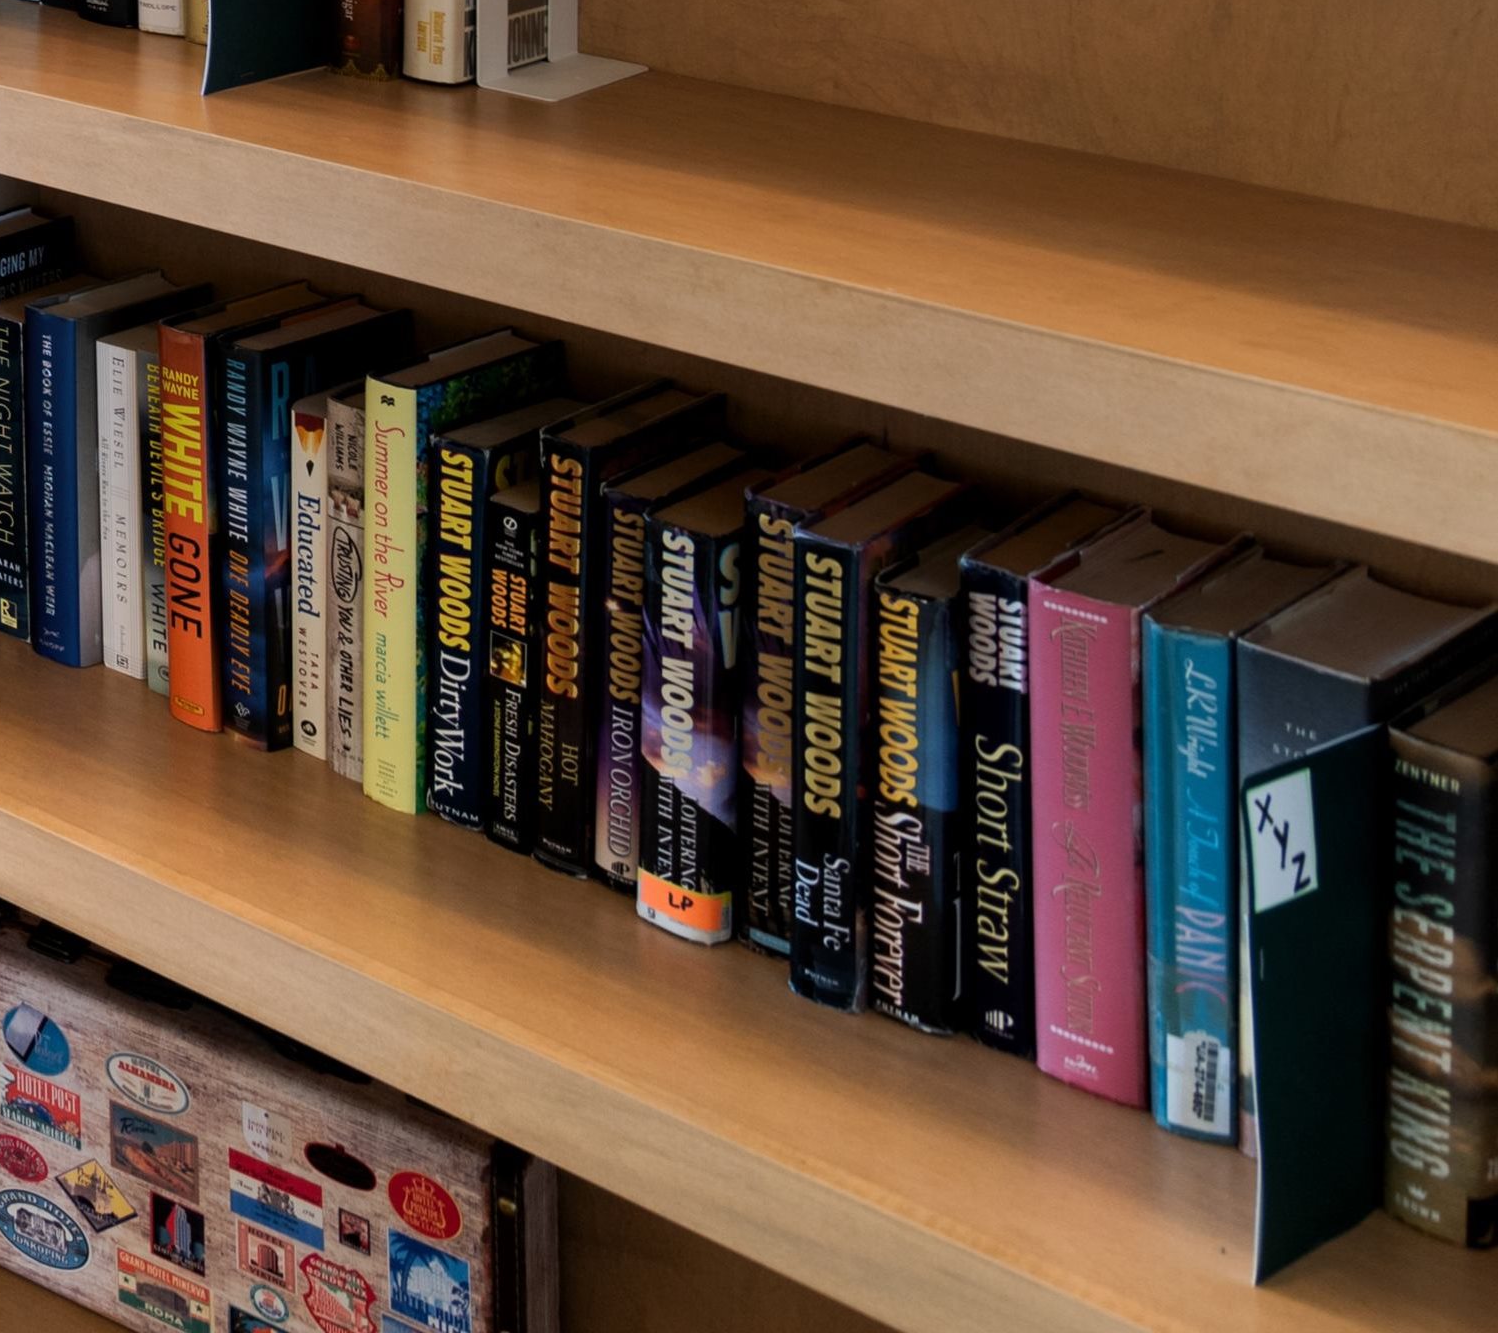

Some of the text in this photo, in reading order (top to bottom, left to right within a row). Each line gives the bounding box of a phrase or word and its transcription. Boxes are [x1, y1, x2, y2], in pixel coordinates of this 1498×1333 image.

[162, 367, 199, 385] RANDY
[162, 379, 200, 400] WAYNE
[162, 402, 203, 524] WHITE
[298, 491, 321, 617] Educated
[438, 449, 473, 651] STUART WOODS
[168, 532, 203, 638] GONE
[1394, 759, 1460, 793] ZENTNER
[795, 858, 821, 927] Dead
[975, 735, 1022, 986] Short Straw
[668, 892, 694, 911] LP
[823, 853, 850, 951] Santa Fe
[1390, 798, 1457, 1179] THE SERPENT KING
[16, 1071, 77, 1115] HOTEL POST
[118, 1061, 177, 1092] ALHAMBRA
[145, 1303, 184, 1327] ROMA
